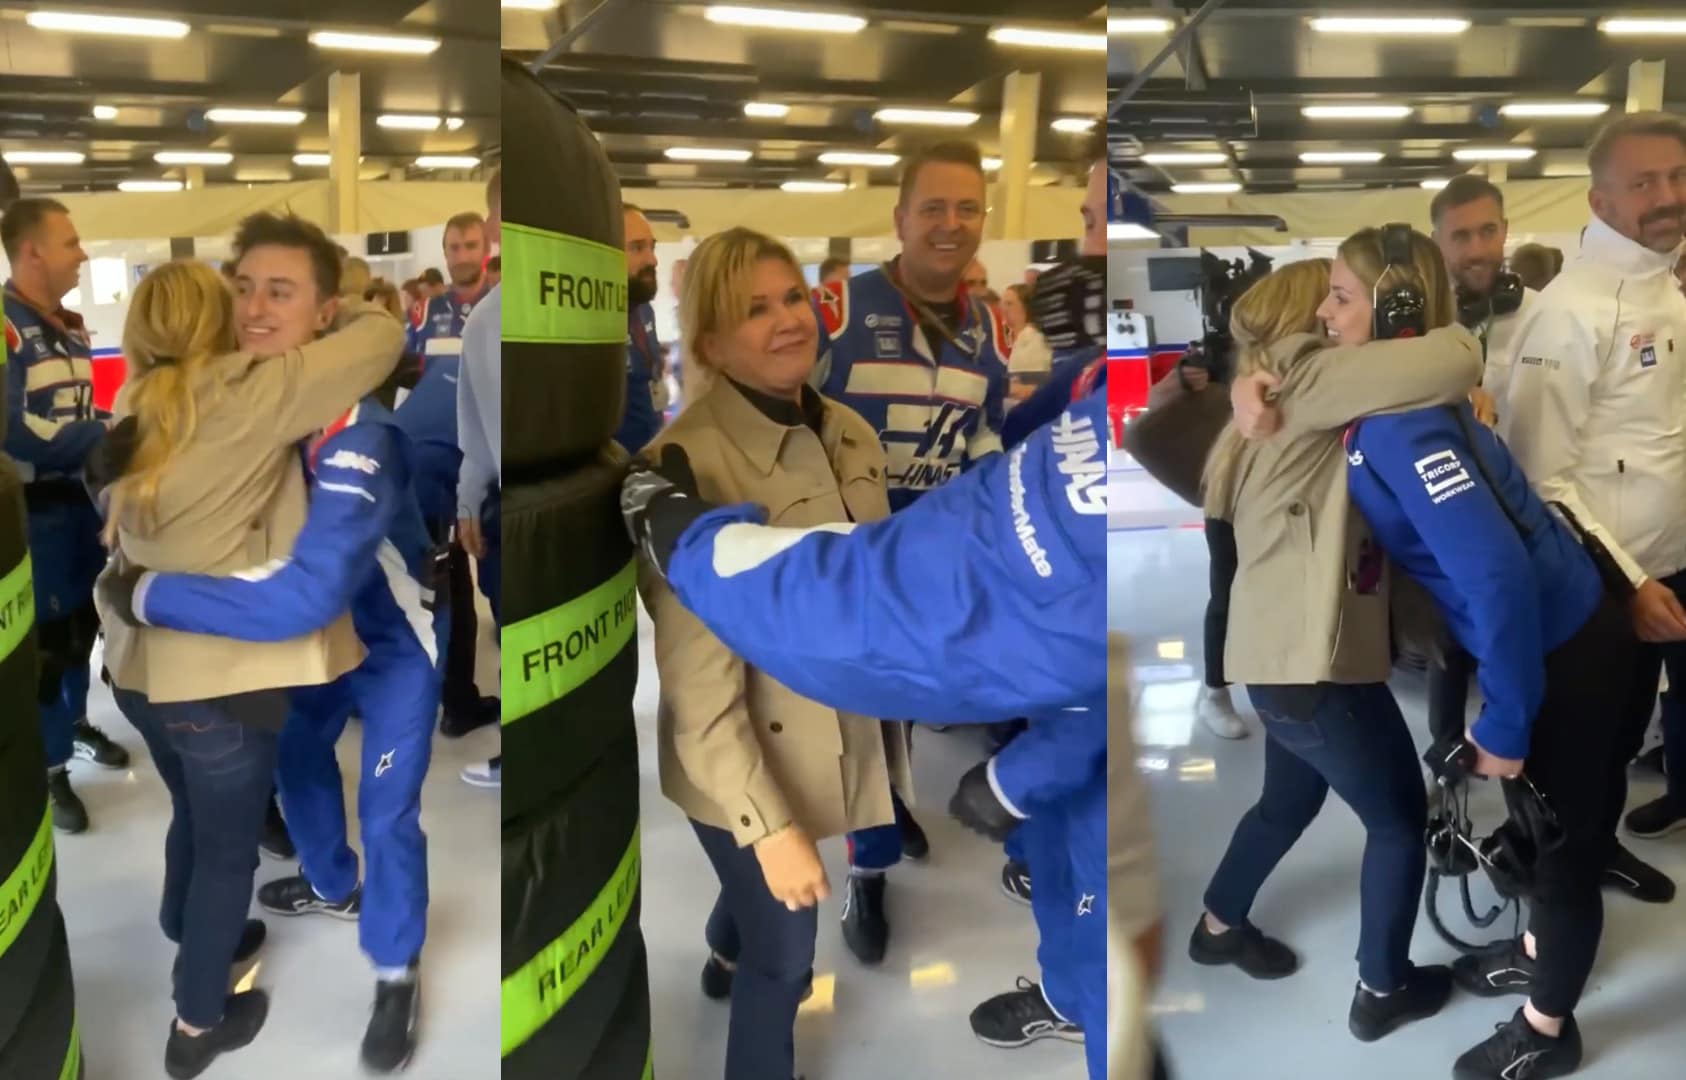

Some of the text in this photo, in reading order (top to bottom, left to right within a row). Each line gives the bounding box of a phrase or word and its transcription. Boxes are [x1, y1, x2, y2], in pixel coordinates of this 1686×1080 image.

[540, 271, 614, 313] FRONT
[1421, 460, 1461, 482] TRICORP
[523, 610, 609, 682] FRONT
[539, 918, 603, 1003] REAR
